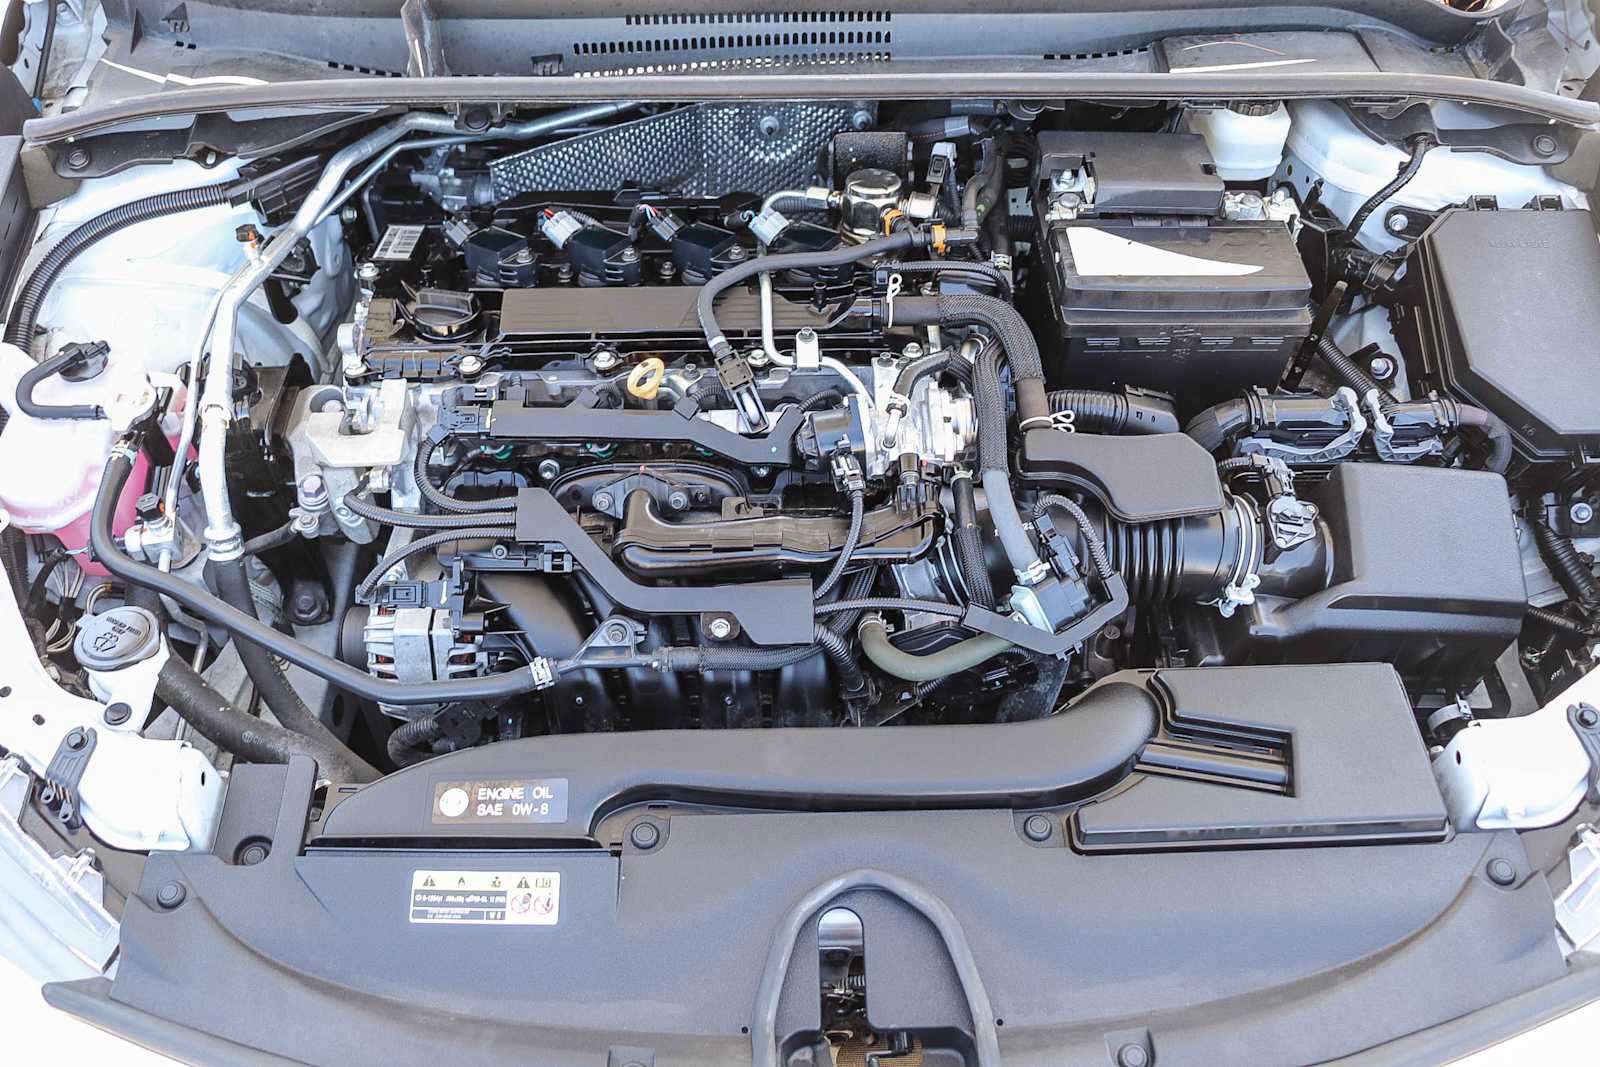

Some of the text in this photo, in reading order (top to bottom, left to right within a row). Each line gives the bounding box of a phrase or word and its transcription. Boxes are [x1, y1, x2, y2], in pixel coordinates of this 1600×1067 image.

[477, 786, 554, 801] ENGINE OIL
[476, 802, 549, 816] SAE 0W-8
